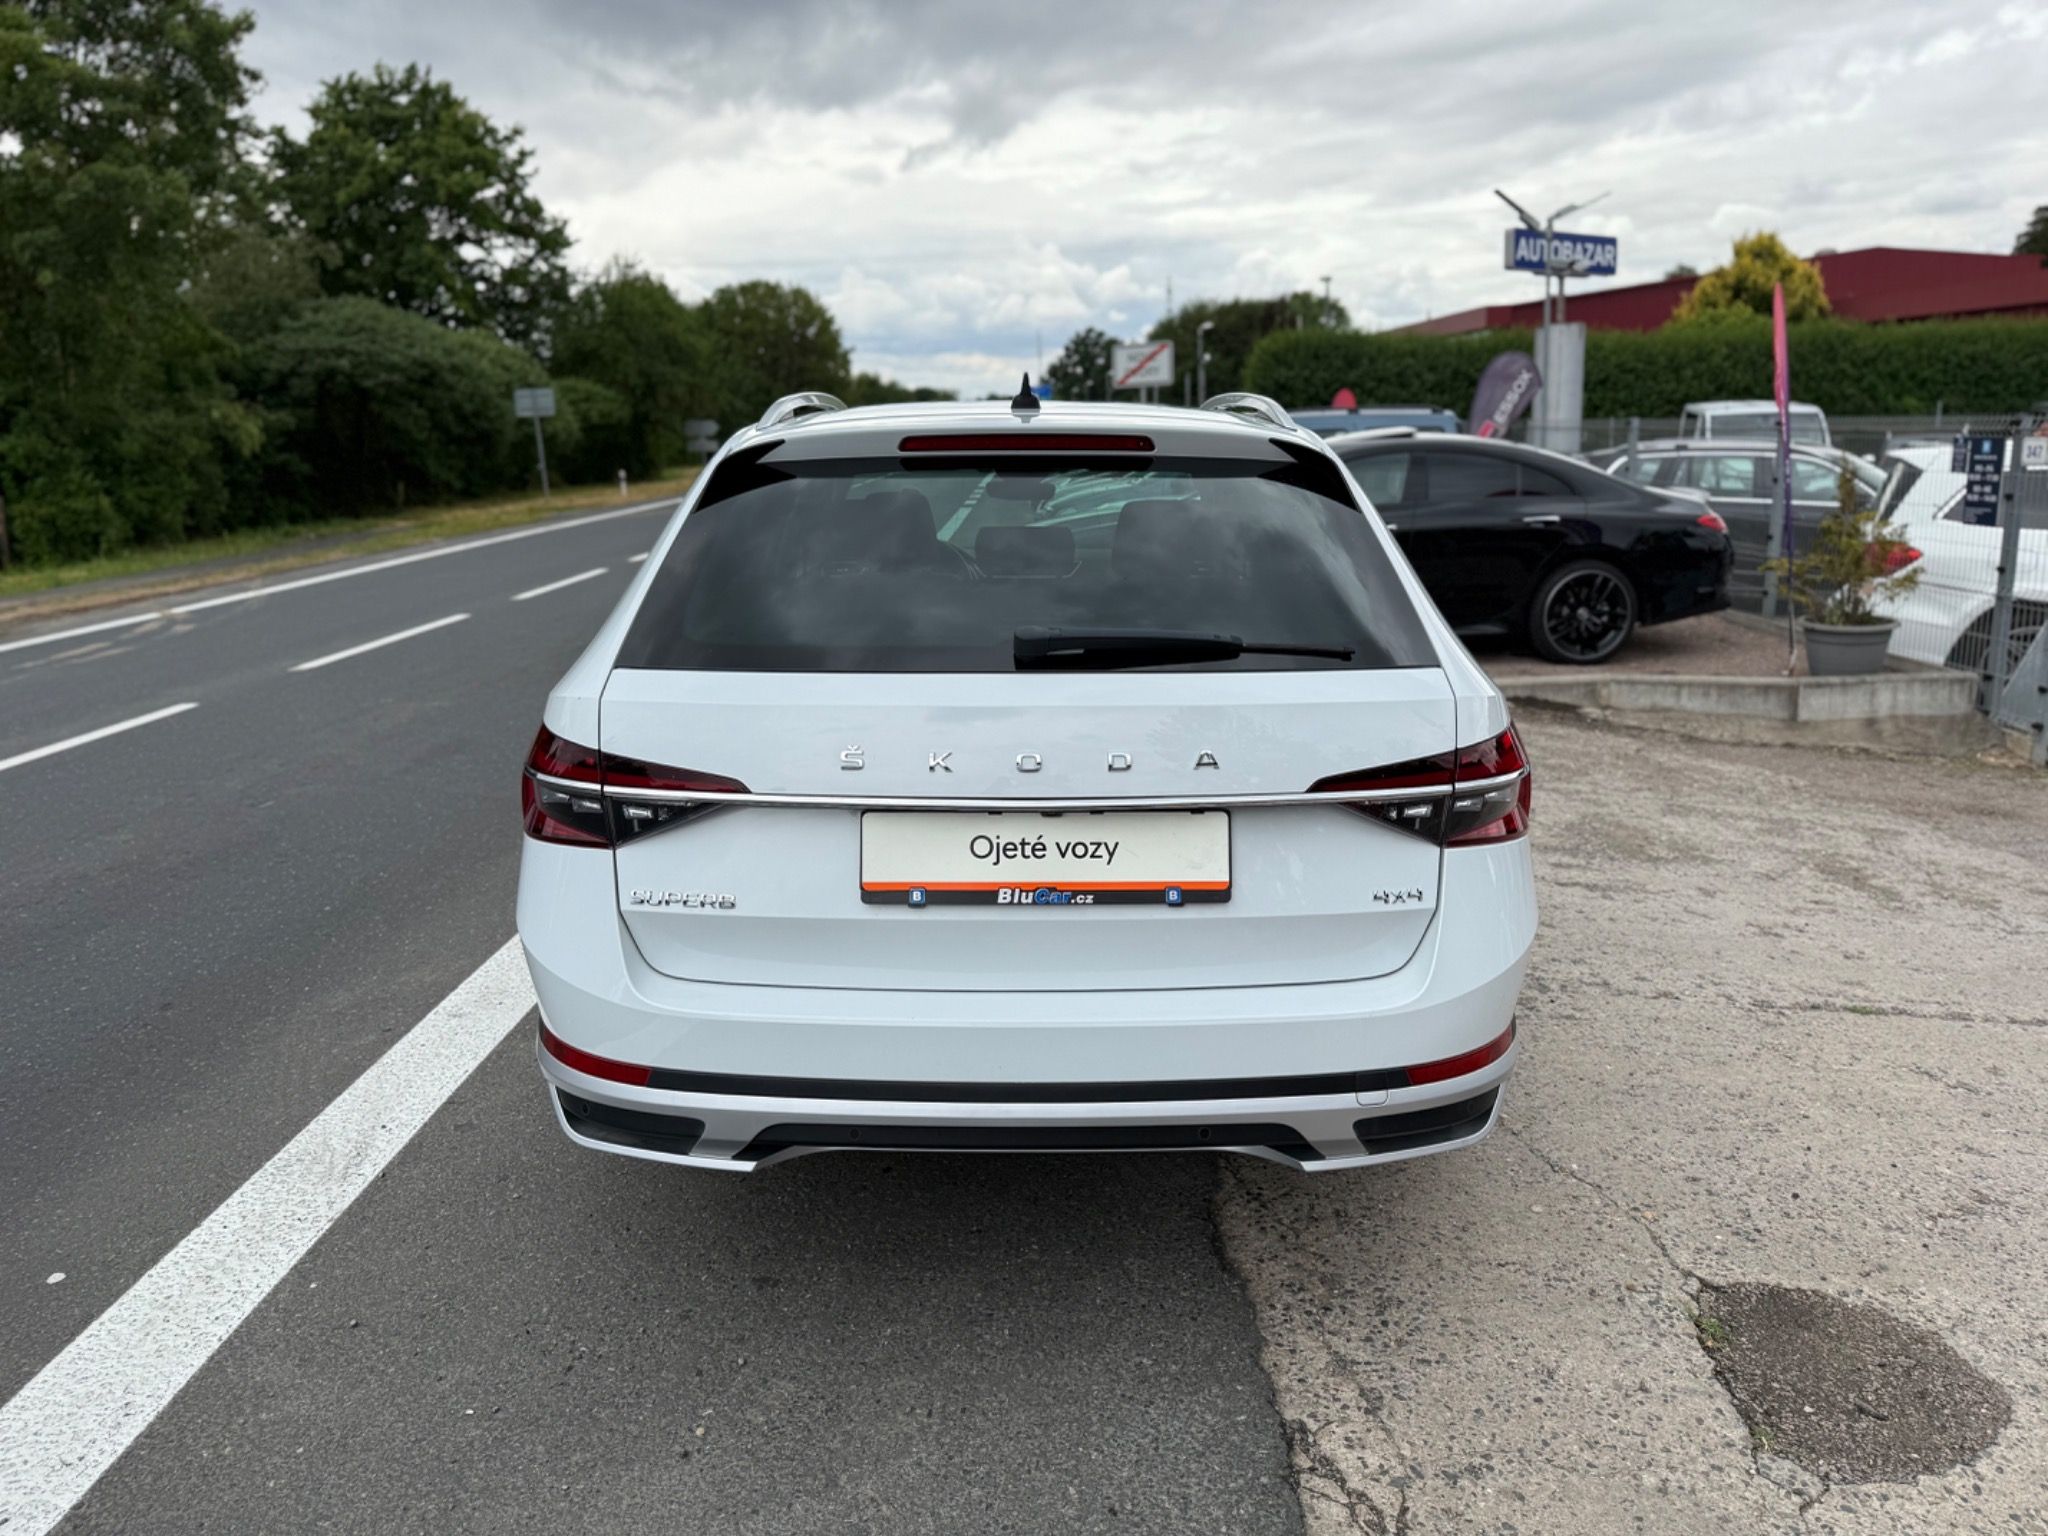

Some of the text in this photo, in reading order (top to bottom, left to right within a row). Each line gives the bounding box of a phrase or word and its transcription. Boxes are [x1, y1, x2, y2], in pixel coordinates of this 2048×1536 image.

[1516, 236, 1615, 268] AUTOBAZAR
[840, 744, 1220, 772] ŠKODA
[969, 833, 1120, 866] Ojeté vozy
[630, 888, 736, 909] SUPERB
[997, 887, 1095, 905] BluCar.cz
